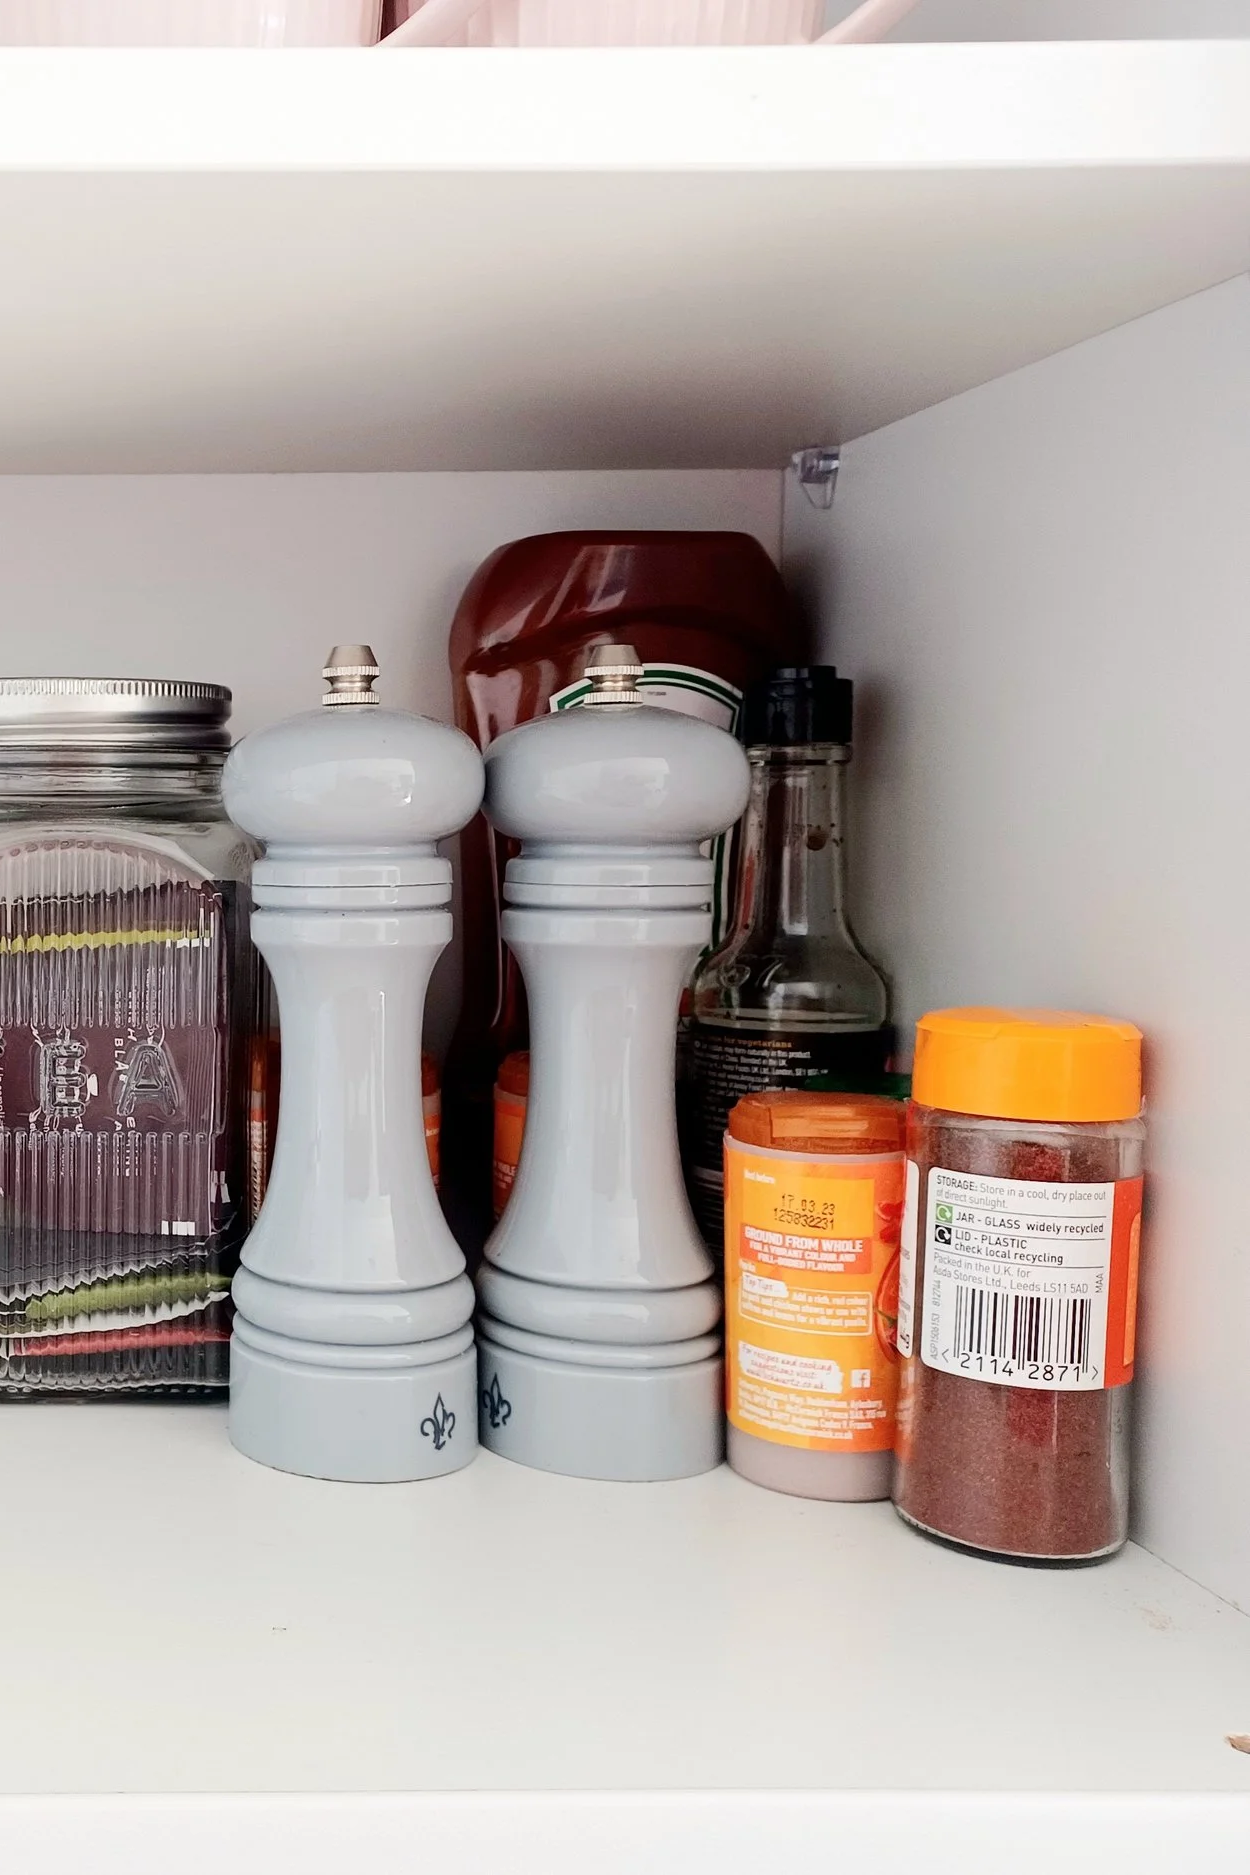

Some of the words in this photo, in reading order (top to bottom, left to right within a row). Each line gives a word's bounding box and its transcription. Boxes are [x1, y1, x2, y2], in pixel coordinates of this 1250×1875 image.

[936, 1174, 978, 1192] STORAGE:
[980, 1183, 1005, 1196] Store
[1007, 1187, 1015, 1196] in
[1018, 1189, 1024, 1197] a
[1027, 1189, 1049, 1201] cool,
[1052, 1190, 1068, 1203] dry
[1069, 1190, 1092, 1203] place
[1093, 1191, 1106, 1201] out
[936, 1188, 944, 1197] of
[944, 1189, 967, 1203] direct
[969, 1194, 1008, 1210] sunlight.
[955, 1211, 975, 1223] JAR
[984, 1216, 1021, 1230] GLASS
[1026, 1222, 1062, 1236] widely
[1064, 1222, 1104, 1235] recycled
[744, 1226, 783, 1246] GROUND
[785, 1234, 819, 1251] FROM
[822, 1240, 864, 1253] WHOLE
[955, 1229, 971, 1242] LID
[980, 1234, 1028, 1249] PLASTIC
[749, 1240, 763, 1250] FOR
[769, 1246, 803, 1258] VIBRANT
[839, 1253, 856, 1263] AND
[954, 1242, 983, 1255] check
[985, 1246, 1011, 1260] local
[1014, 1249, 1064, 1265] recycling
[807, 1260, 845, 1272] FLAVOUR
[934, 1251, 962, 1268] Packed
[964, 1258, 973, 1270] in
[975, 1260, 990, 1272] the
[993, 1262, 1014, 1276] U.K.
[1016, 1266, 1031, 1279] for
[933, 1265, 952, 1279] Asda
[953, 1268, 983, 1284] Stores
[985, 1273, 1007, 1289] Ltd.,
[1010, 1276, 1041, 1292] Leeds
[1043, 1281, 1067, 1293] LS11
[1070, 1283, 1089, 1294] 5AD
[1095, 1273, 1104, 1294] MAA
[960, 1352, 1014, 1377] 2114
[1028, 1363, 1081, 1383] 2871
